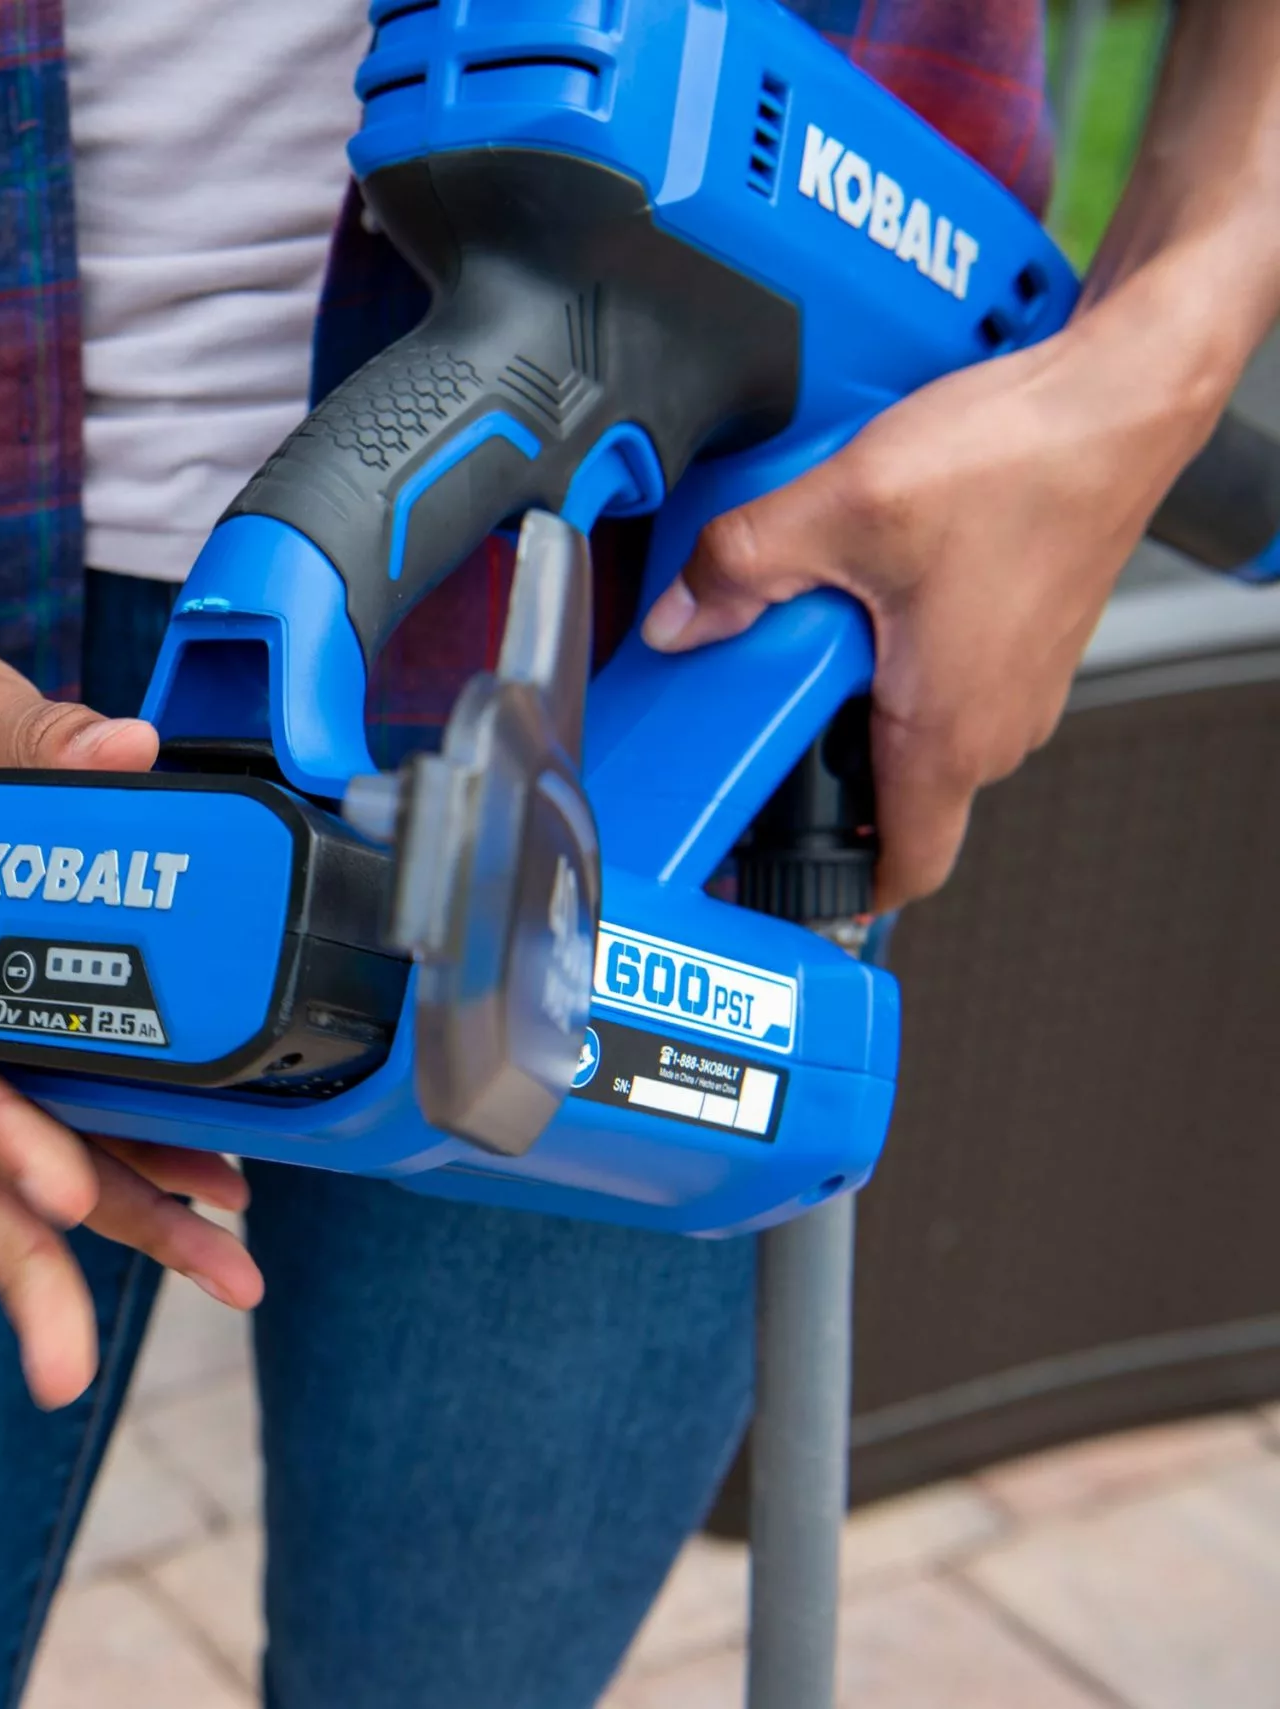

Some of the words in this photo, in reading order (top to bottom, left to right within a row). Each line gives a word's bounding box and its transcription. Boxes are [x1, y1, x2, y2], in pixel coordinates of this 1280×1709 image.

[798, 122, 980, 301] KOBALT
[606, 939, 711, 1017] 600
[711, 985, 756, 1030] PSI
[28, 1010, 87, 1033] MAX
[98, 1010, 136, 1035] 2.5
[138, 1023, 157, 1038] Ah
[672, 1051, 740, 1081] 1-888-3KOBALT
[613, 1077, 631, 1094] SN:
